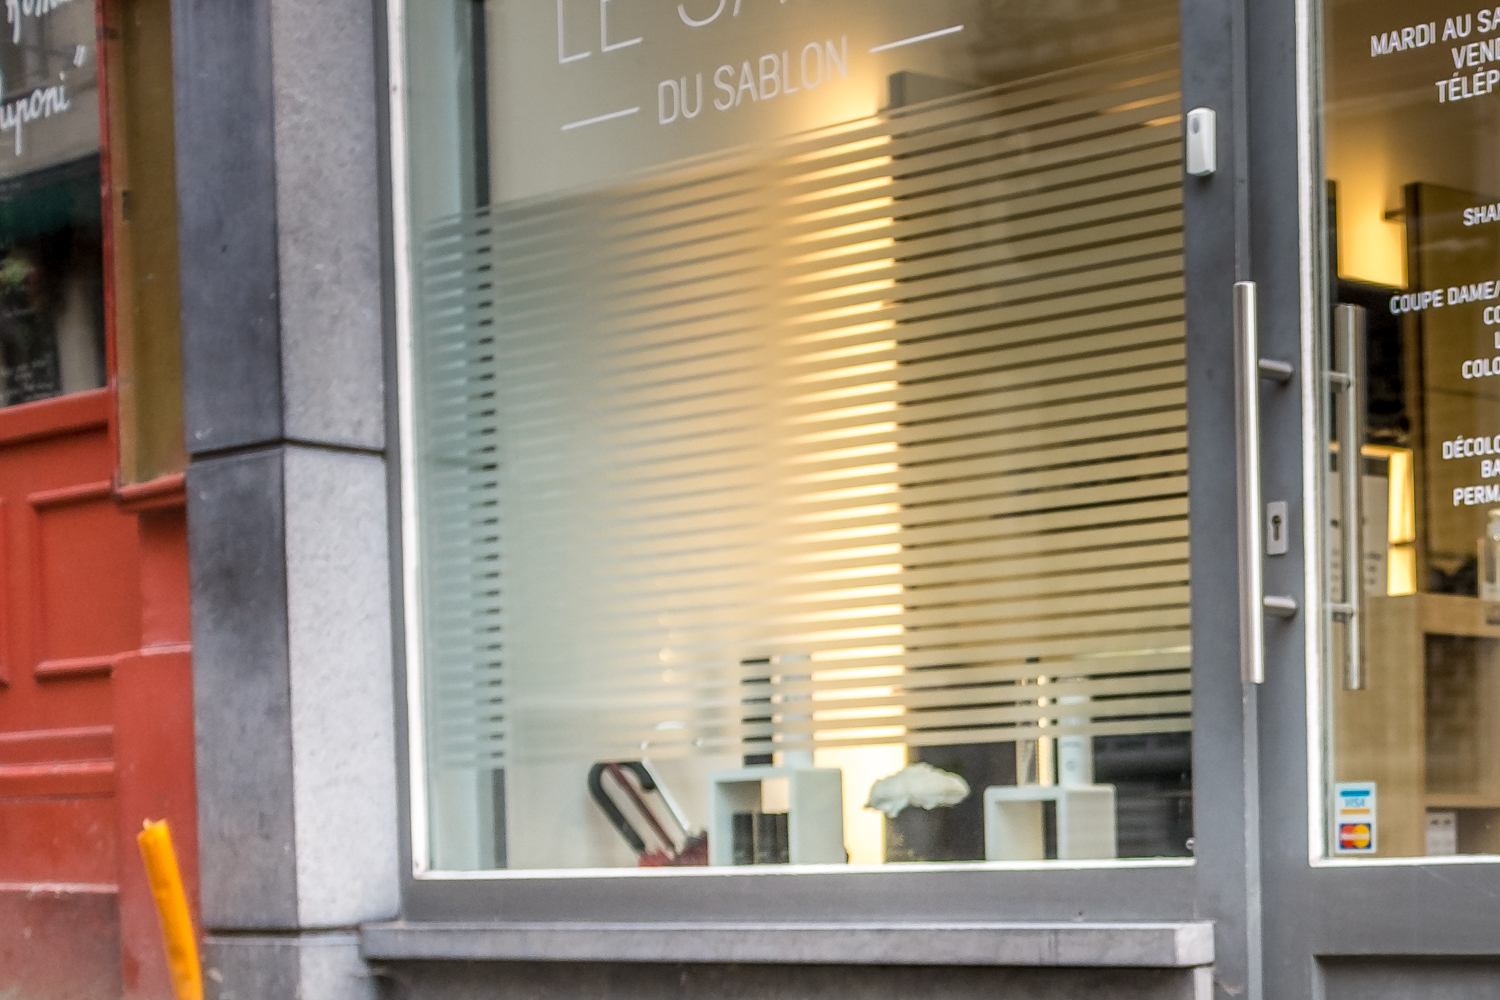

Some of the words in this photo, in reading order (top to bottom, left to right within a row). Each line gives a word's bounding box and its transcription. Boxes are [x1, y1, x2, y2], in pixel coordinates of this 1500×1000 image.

[1370, 22, 1436, 57] MARDI
[1442, 13, 1472, 41] AU
[657, 72, 702, 125] DU
[713, 36, 848, 111] SABLON
[1389, 288, 1444, 315] COUPE
